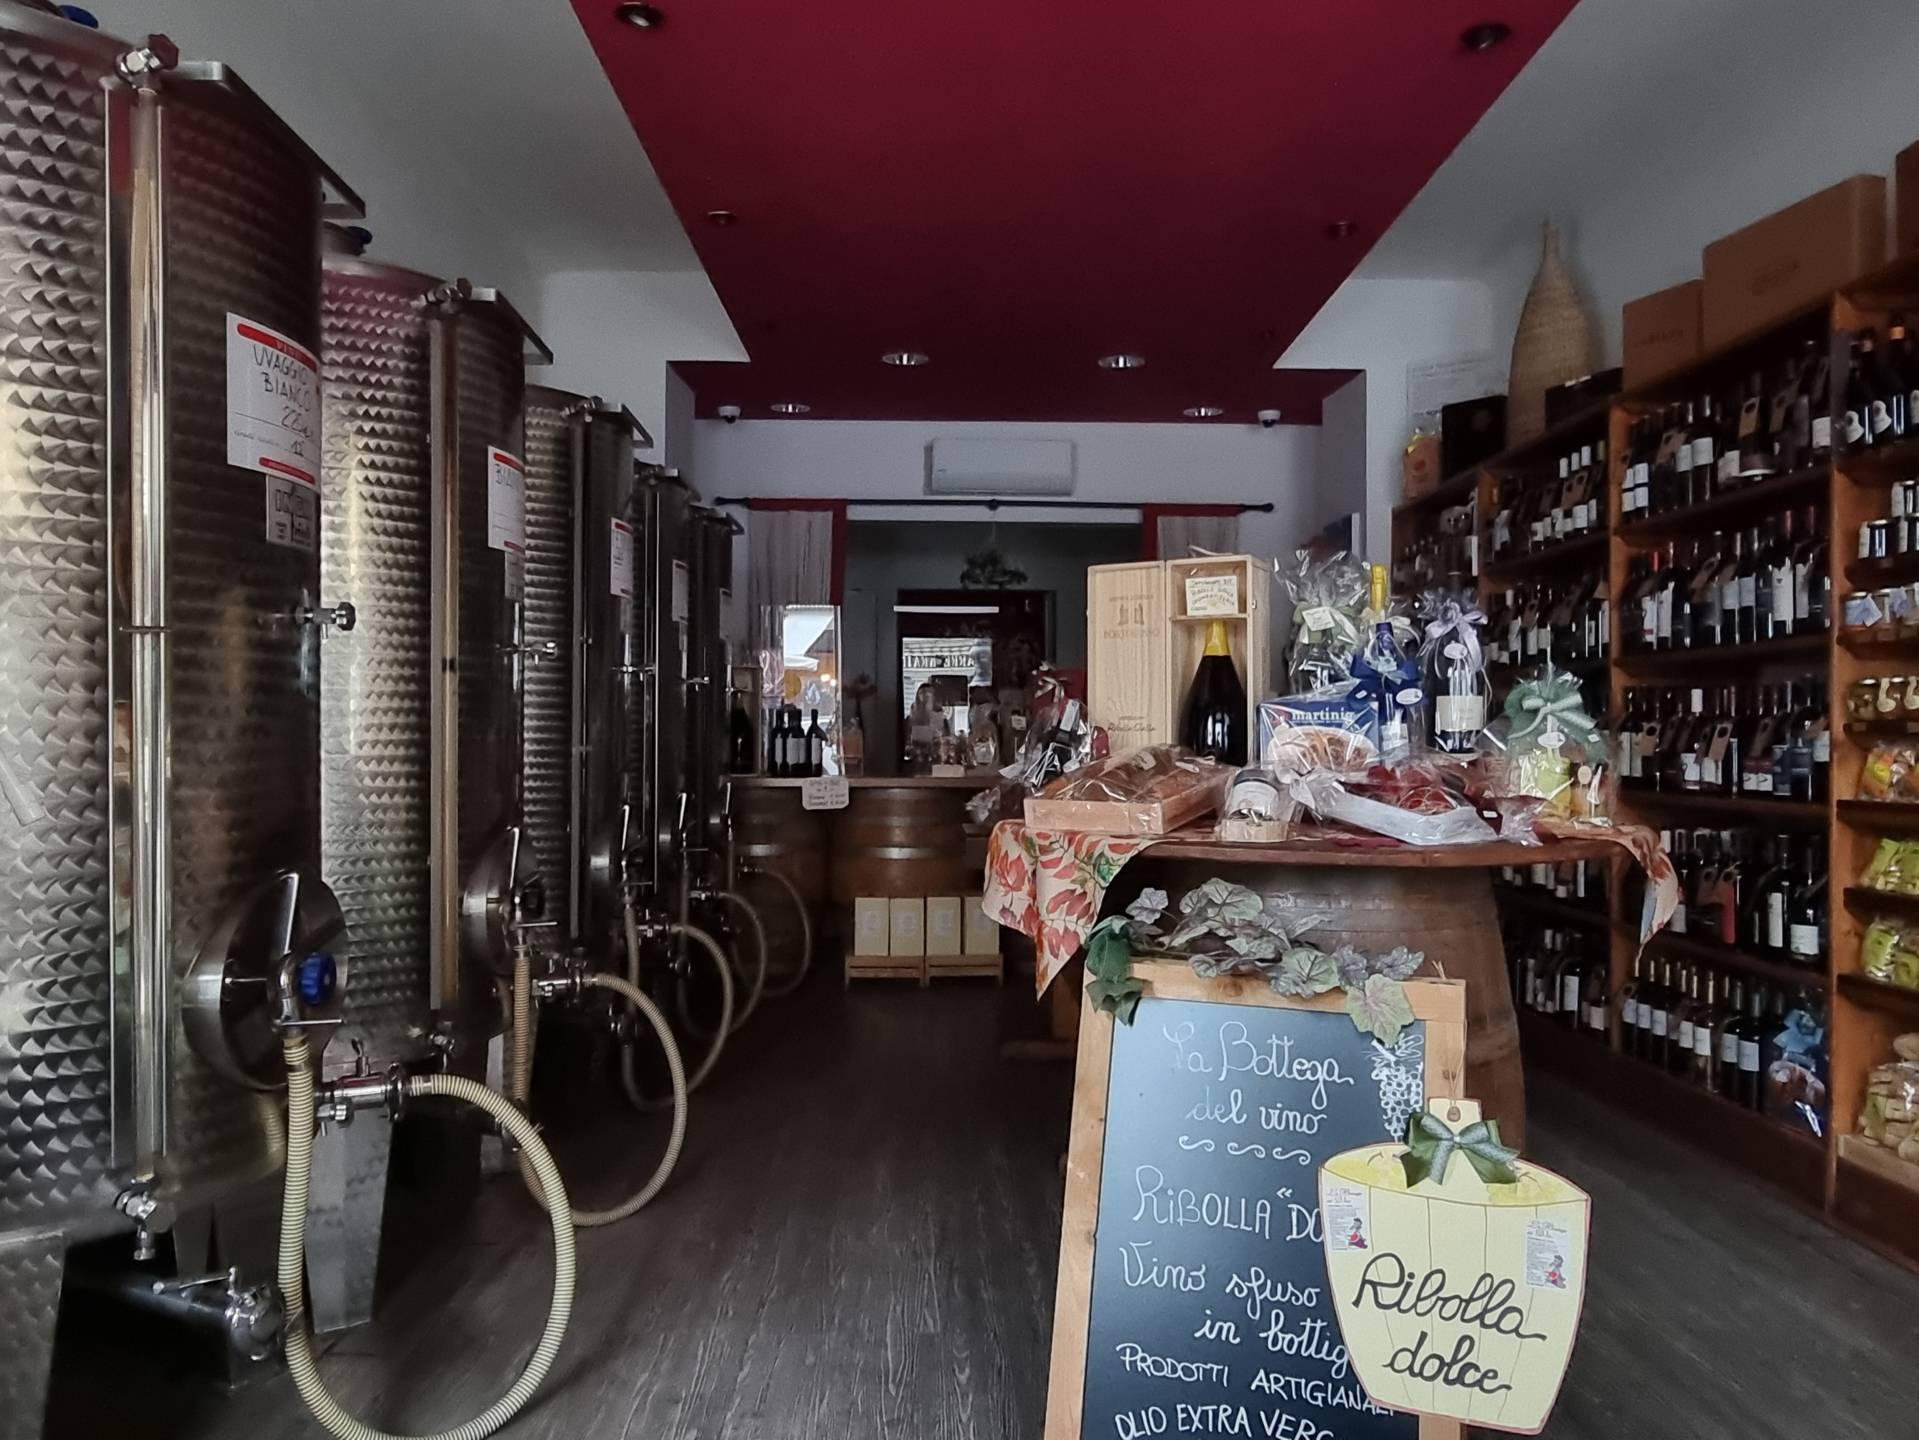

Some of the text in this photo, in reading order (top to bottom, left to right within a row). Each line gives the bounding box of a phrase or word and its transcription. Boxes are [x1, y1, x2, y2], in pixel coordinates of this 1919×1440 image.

[1162, 1020, 1213, 1075] La
[1218, 1020, 1355, 1111] Bottega
[1184, 1086, 1328, 1135] del vino
[1118, 1240, 1321, 1320] Vino sfuso
[1351, 1251, 1548, 1342] Ribolla
[1193, 1309, 1242, 1345] in
[1115, 1342, 1229, 1387] PRODOTTI
[1381, 1330, 1513, 1395] dolce
[1114, 1406, 1168, 1440] OLIO
[1176, 1403, 1252, 1438] EXTRA
